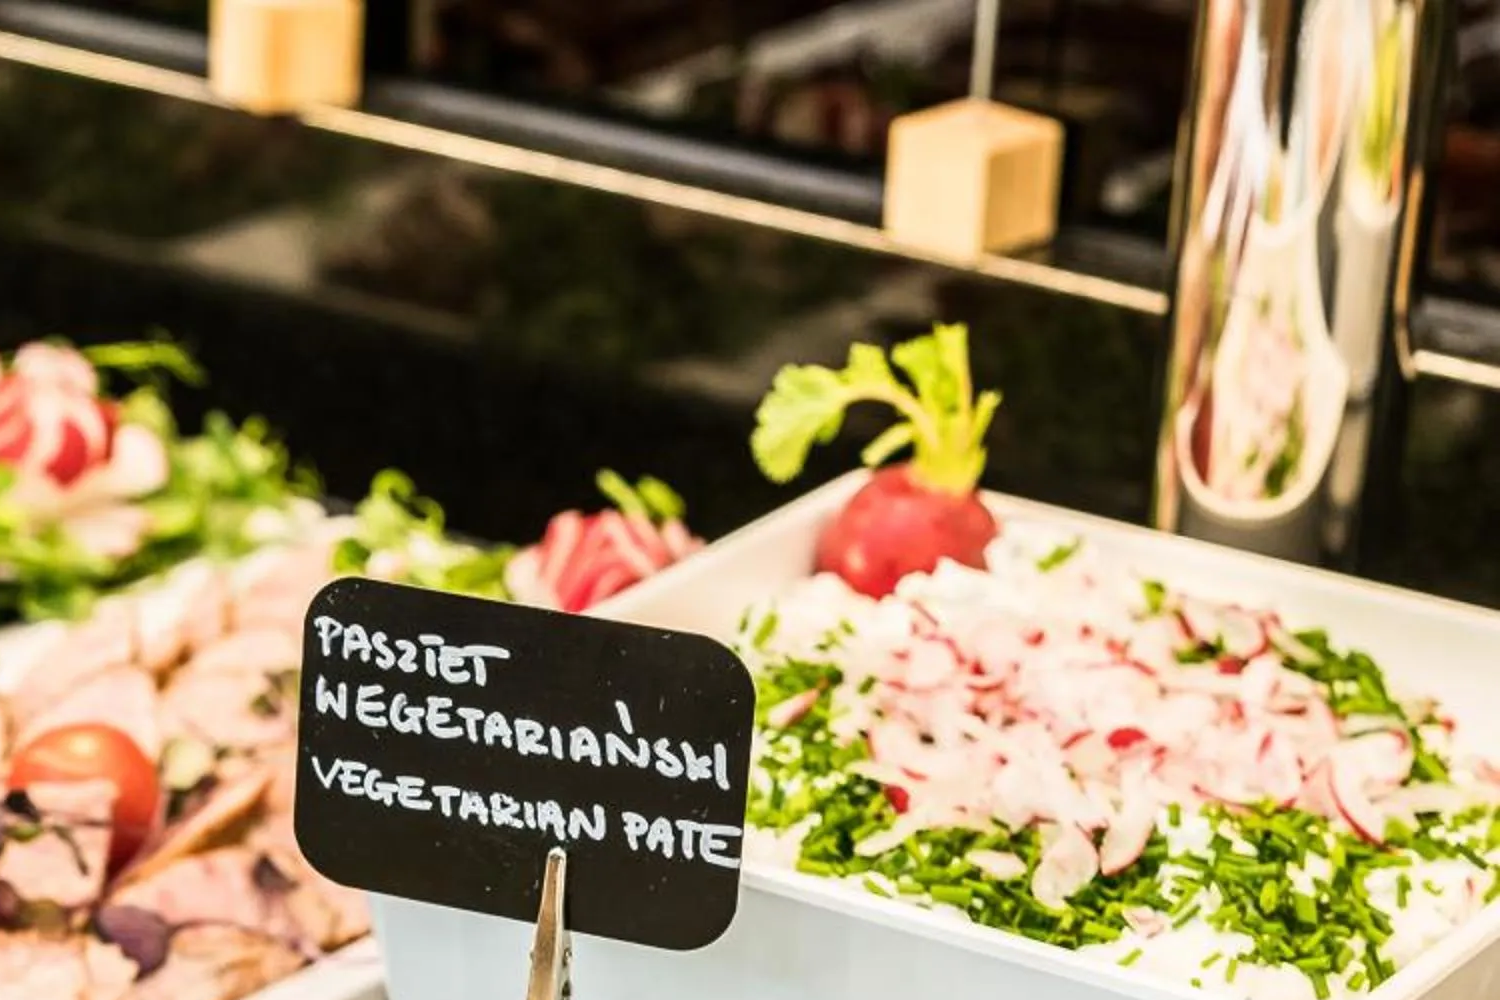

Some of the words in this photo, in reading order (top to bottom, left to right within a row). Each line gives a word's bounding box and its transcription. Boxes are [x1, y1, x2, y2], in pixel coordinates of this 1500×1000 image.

[313, 615, 511, 687] PASZTET
[311, 756, 606, 841] VEGETARIAN
[621, 811, 743, 869] PATE
